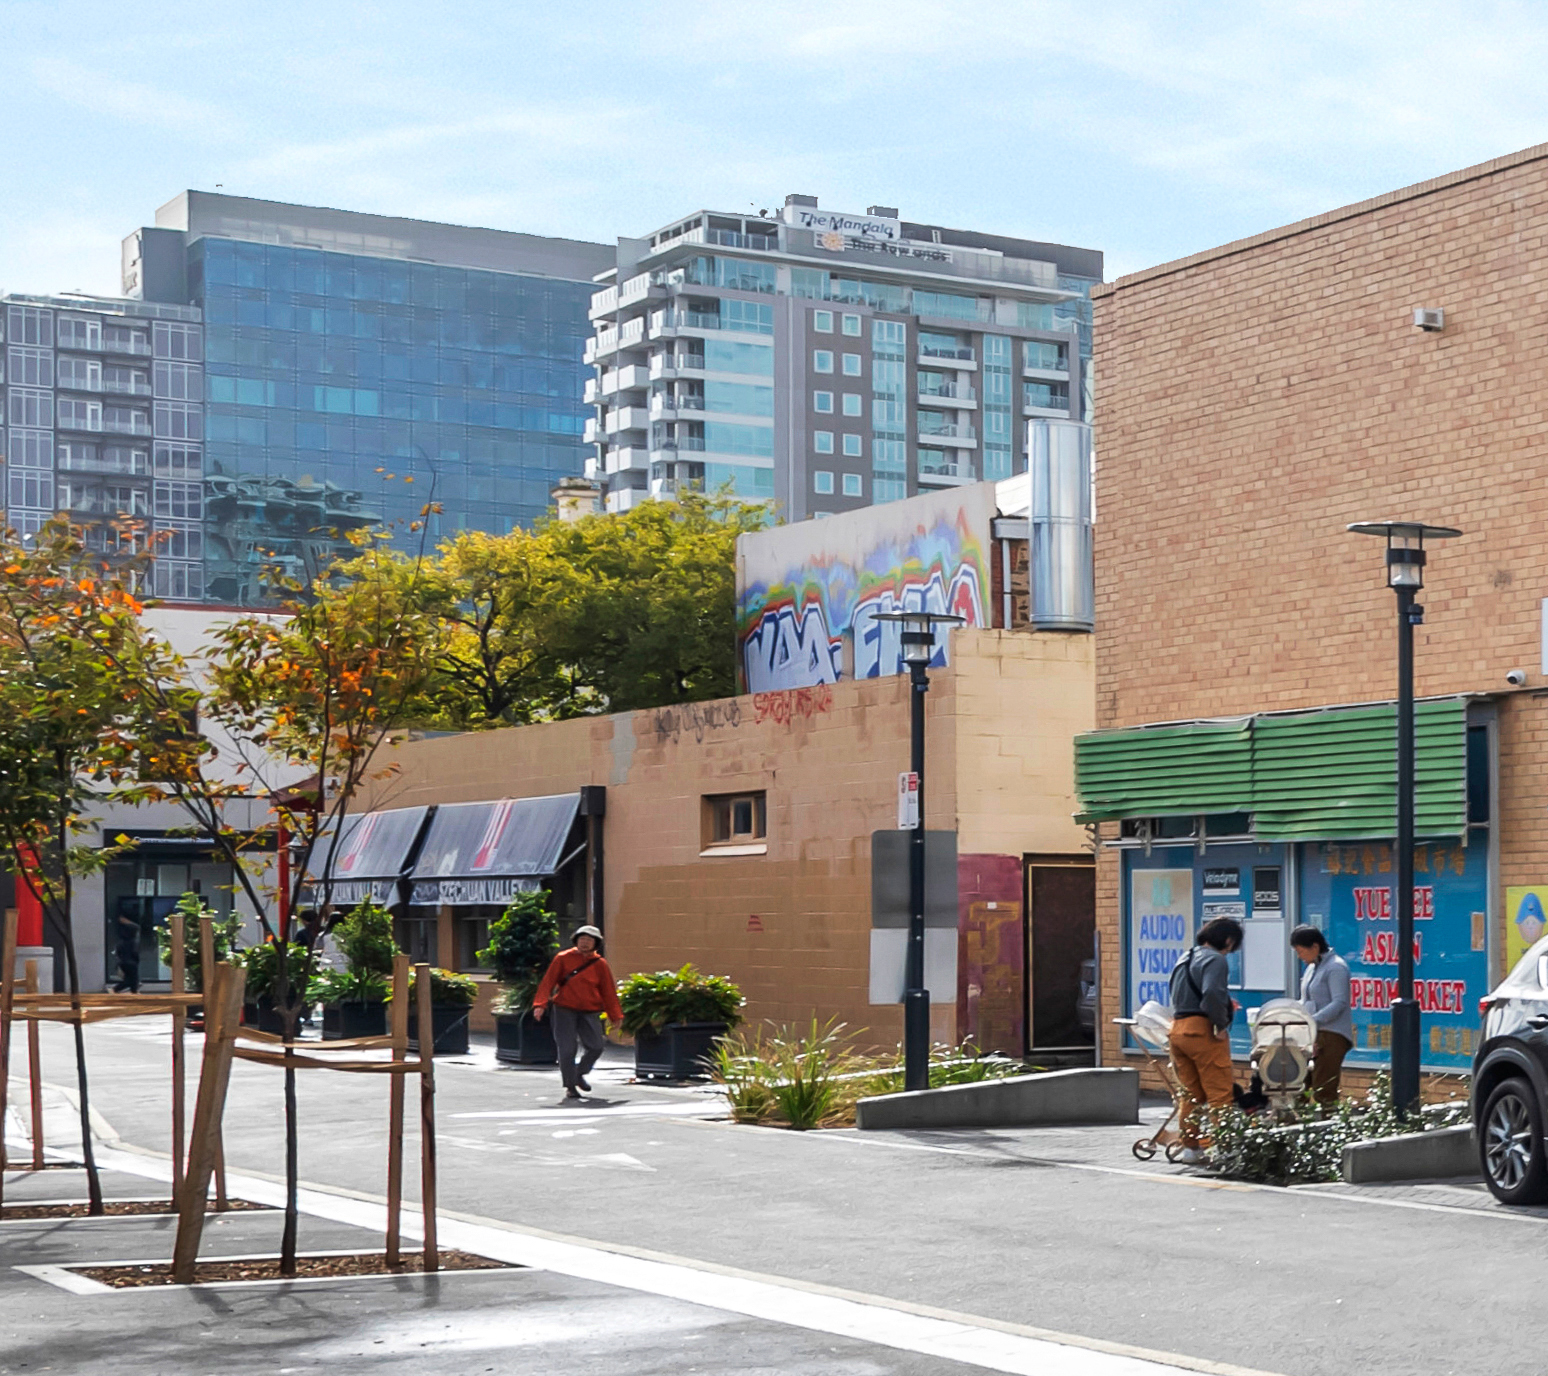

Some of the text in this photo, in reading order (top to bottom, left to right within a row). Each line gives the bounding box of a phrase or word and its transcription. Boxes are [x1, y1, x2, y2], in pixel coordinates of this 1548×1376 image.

[800, 212, 893, 237] The Mandala
[1353, 886, 1391, 921] YUE
[1140, 913, 1186, 941] AUDIO
[1363, 931, 1423, 965] ASIN
